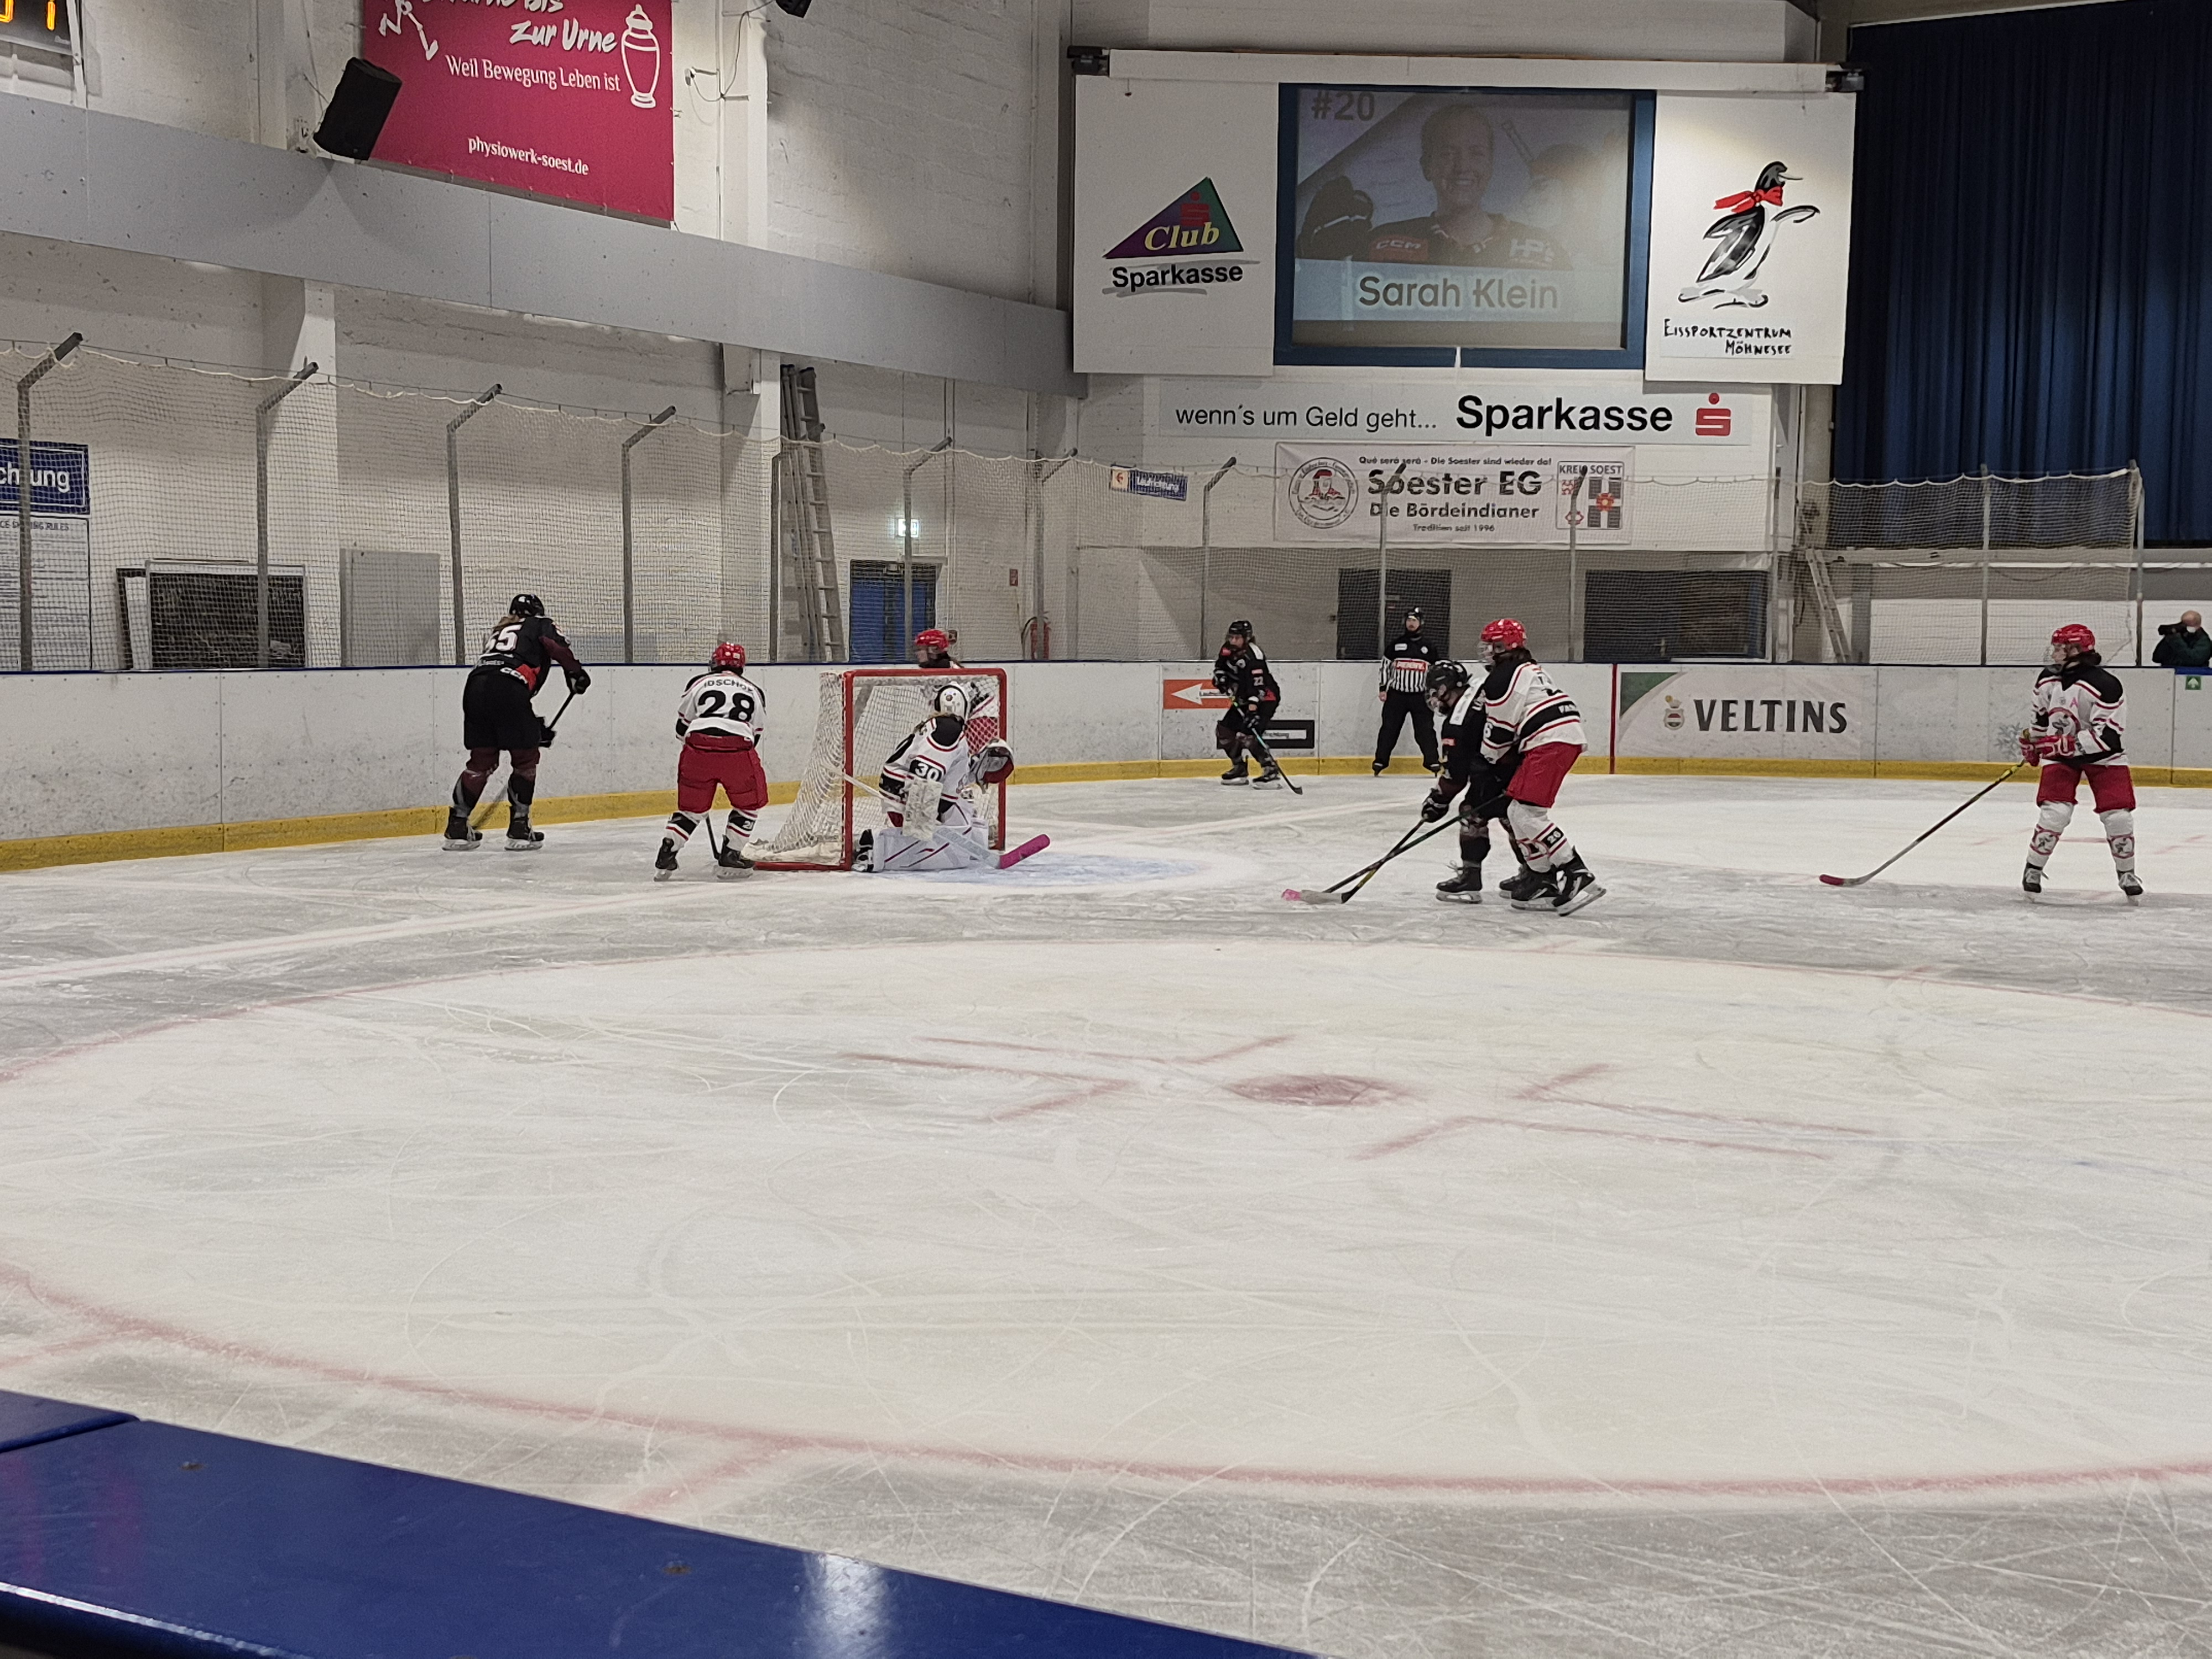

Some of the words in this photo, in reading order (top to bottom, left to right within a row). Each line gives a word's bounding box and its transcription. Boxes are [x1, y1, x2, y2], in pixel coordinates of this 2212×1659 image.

[562, 18, 617, 53] Urne
[445, 55, 479, 78] Weil
[482, 59, 557, 90] Bewegung
[559, 66, 601, 90] Leben
[603, 72, 621, 92] ist
[1311, 91, 1375, 121] #20
[468, 135, 589, 175] physiowerk-soest.de
[1144, 221, 1219, 251] Club
[1112, 264, 1244, 293] Sparkasse
[1359, 276, 1460, 307] Sarah
[1472, 278, 1558, 309] Klein
[1663, 318, 1792, 338] EISSPORTZENTRUM
[1725, 339, 1792, 356] MÖHNESEE
[1263, 410, 1297, 425] um
[1306, 406, 1358, 427] Geld
[1366, 408, 1437, 433] geht...
[1456, 395, 1673, 437] Sparkasse
[1504, 457, 1534, 466] wieder
[1590, 465, 1623, 474] SOEST
[0, 461, 70, 493] chung
[1368, 469, 1488, 495] Soester
[1499, 471, 1542, 495] EG
[1407, 502, 1540, 518] Bördeindianer
[698, 690, 754, 722] 28
[1693, 699, 1848, 734] VELTINS
[915, 763, 939, 781] 30
